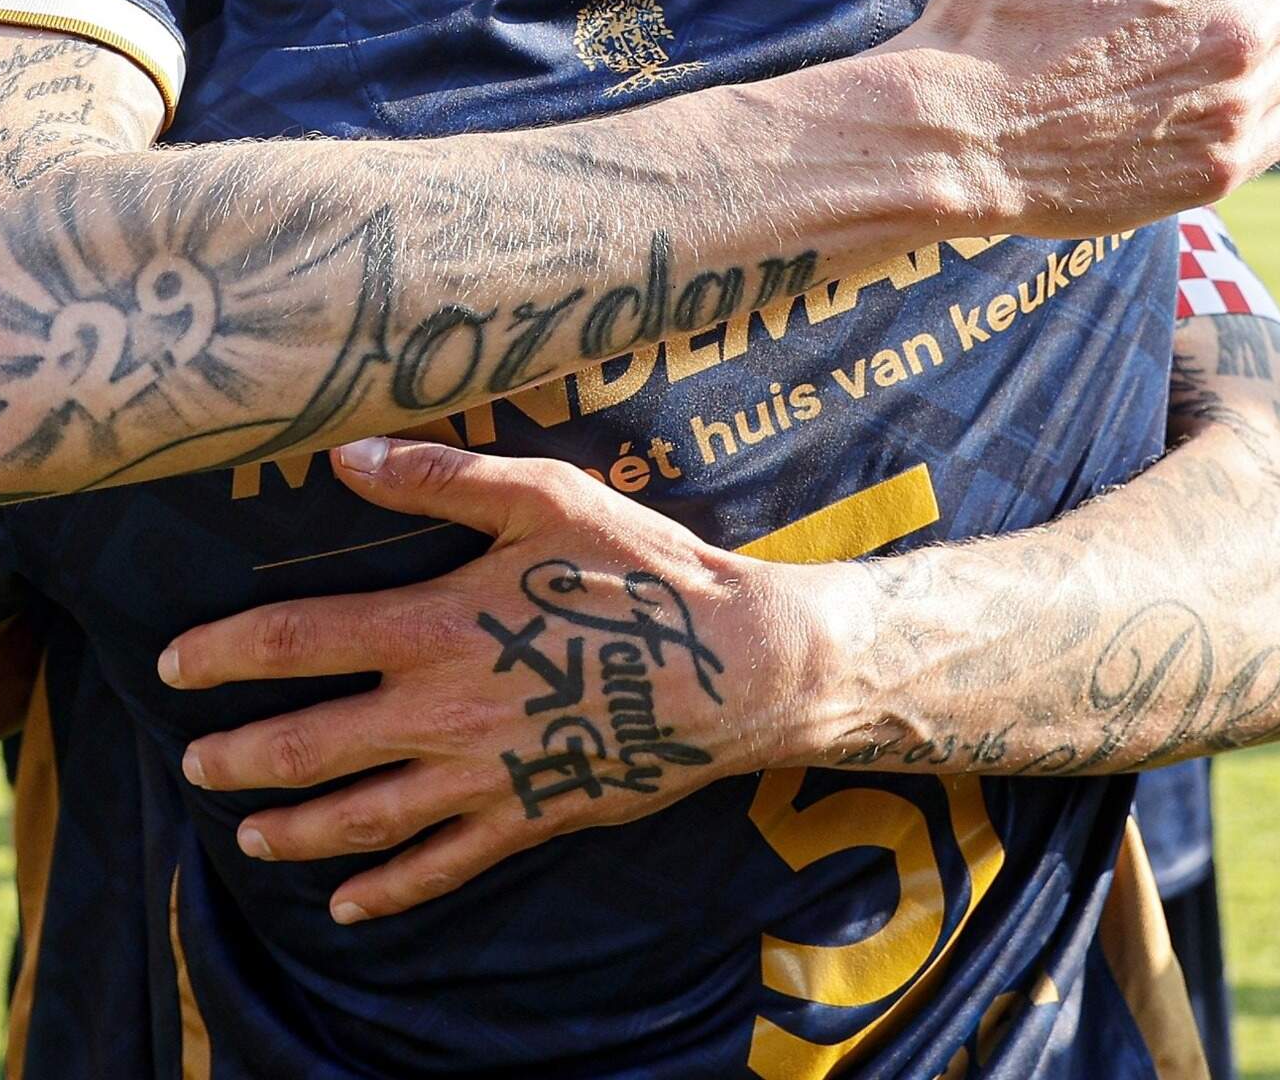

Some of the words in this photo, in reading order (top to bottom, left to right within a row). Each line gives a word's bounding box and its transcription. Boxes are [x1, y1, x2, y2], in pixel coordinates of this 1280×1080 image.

[200, 202, 828, 472] Jordan
[584, 433, 683, 493] ét
[689, 380, 824, 466] huis
[831, 331, 944, 402] van
[519, 558, 725, 795] Family
